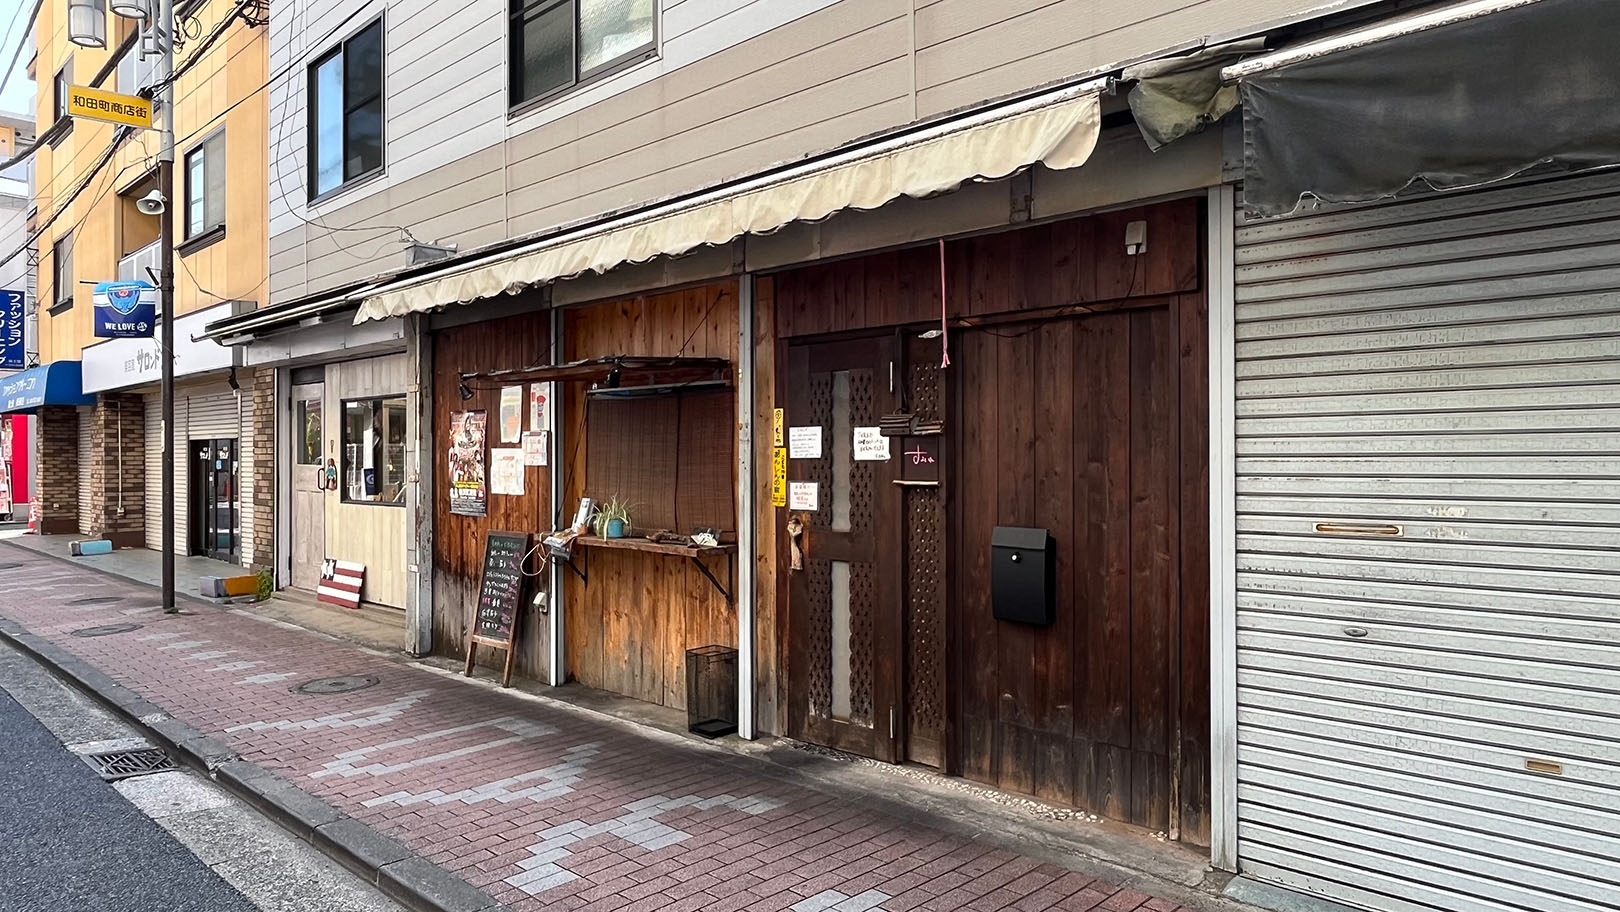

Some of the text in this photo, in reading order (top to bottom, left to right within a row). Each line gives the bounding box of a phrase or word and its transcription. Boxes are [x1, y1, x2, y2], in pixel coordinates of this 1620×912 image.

[73, 95, 147, 118] 和田町商店街
[104, 322, 136, 331] WE LOVE
